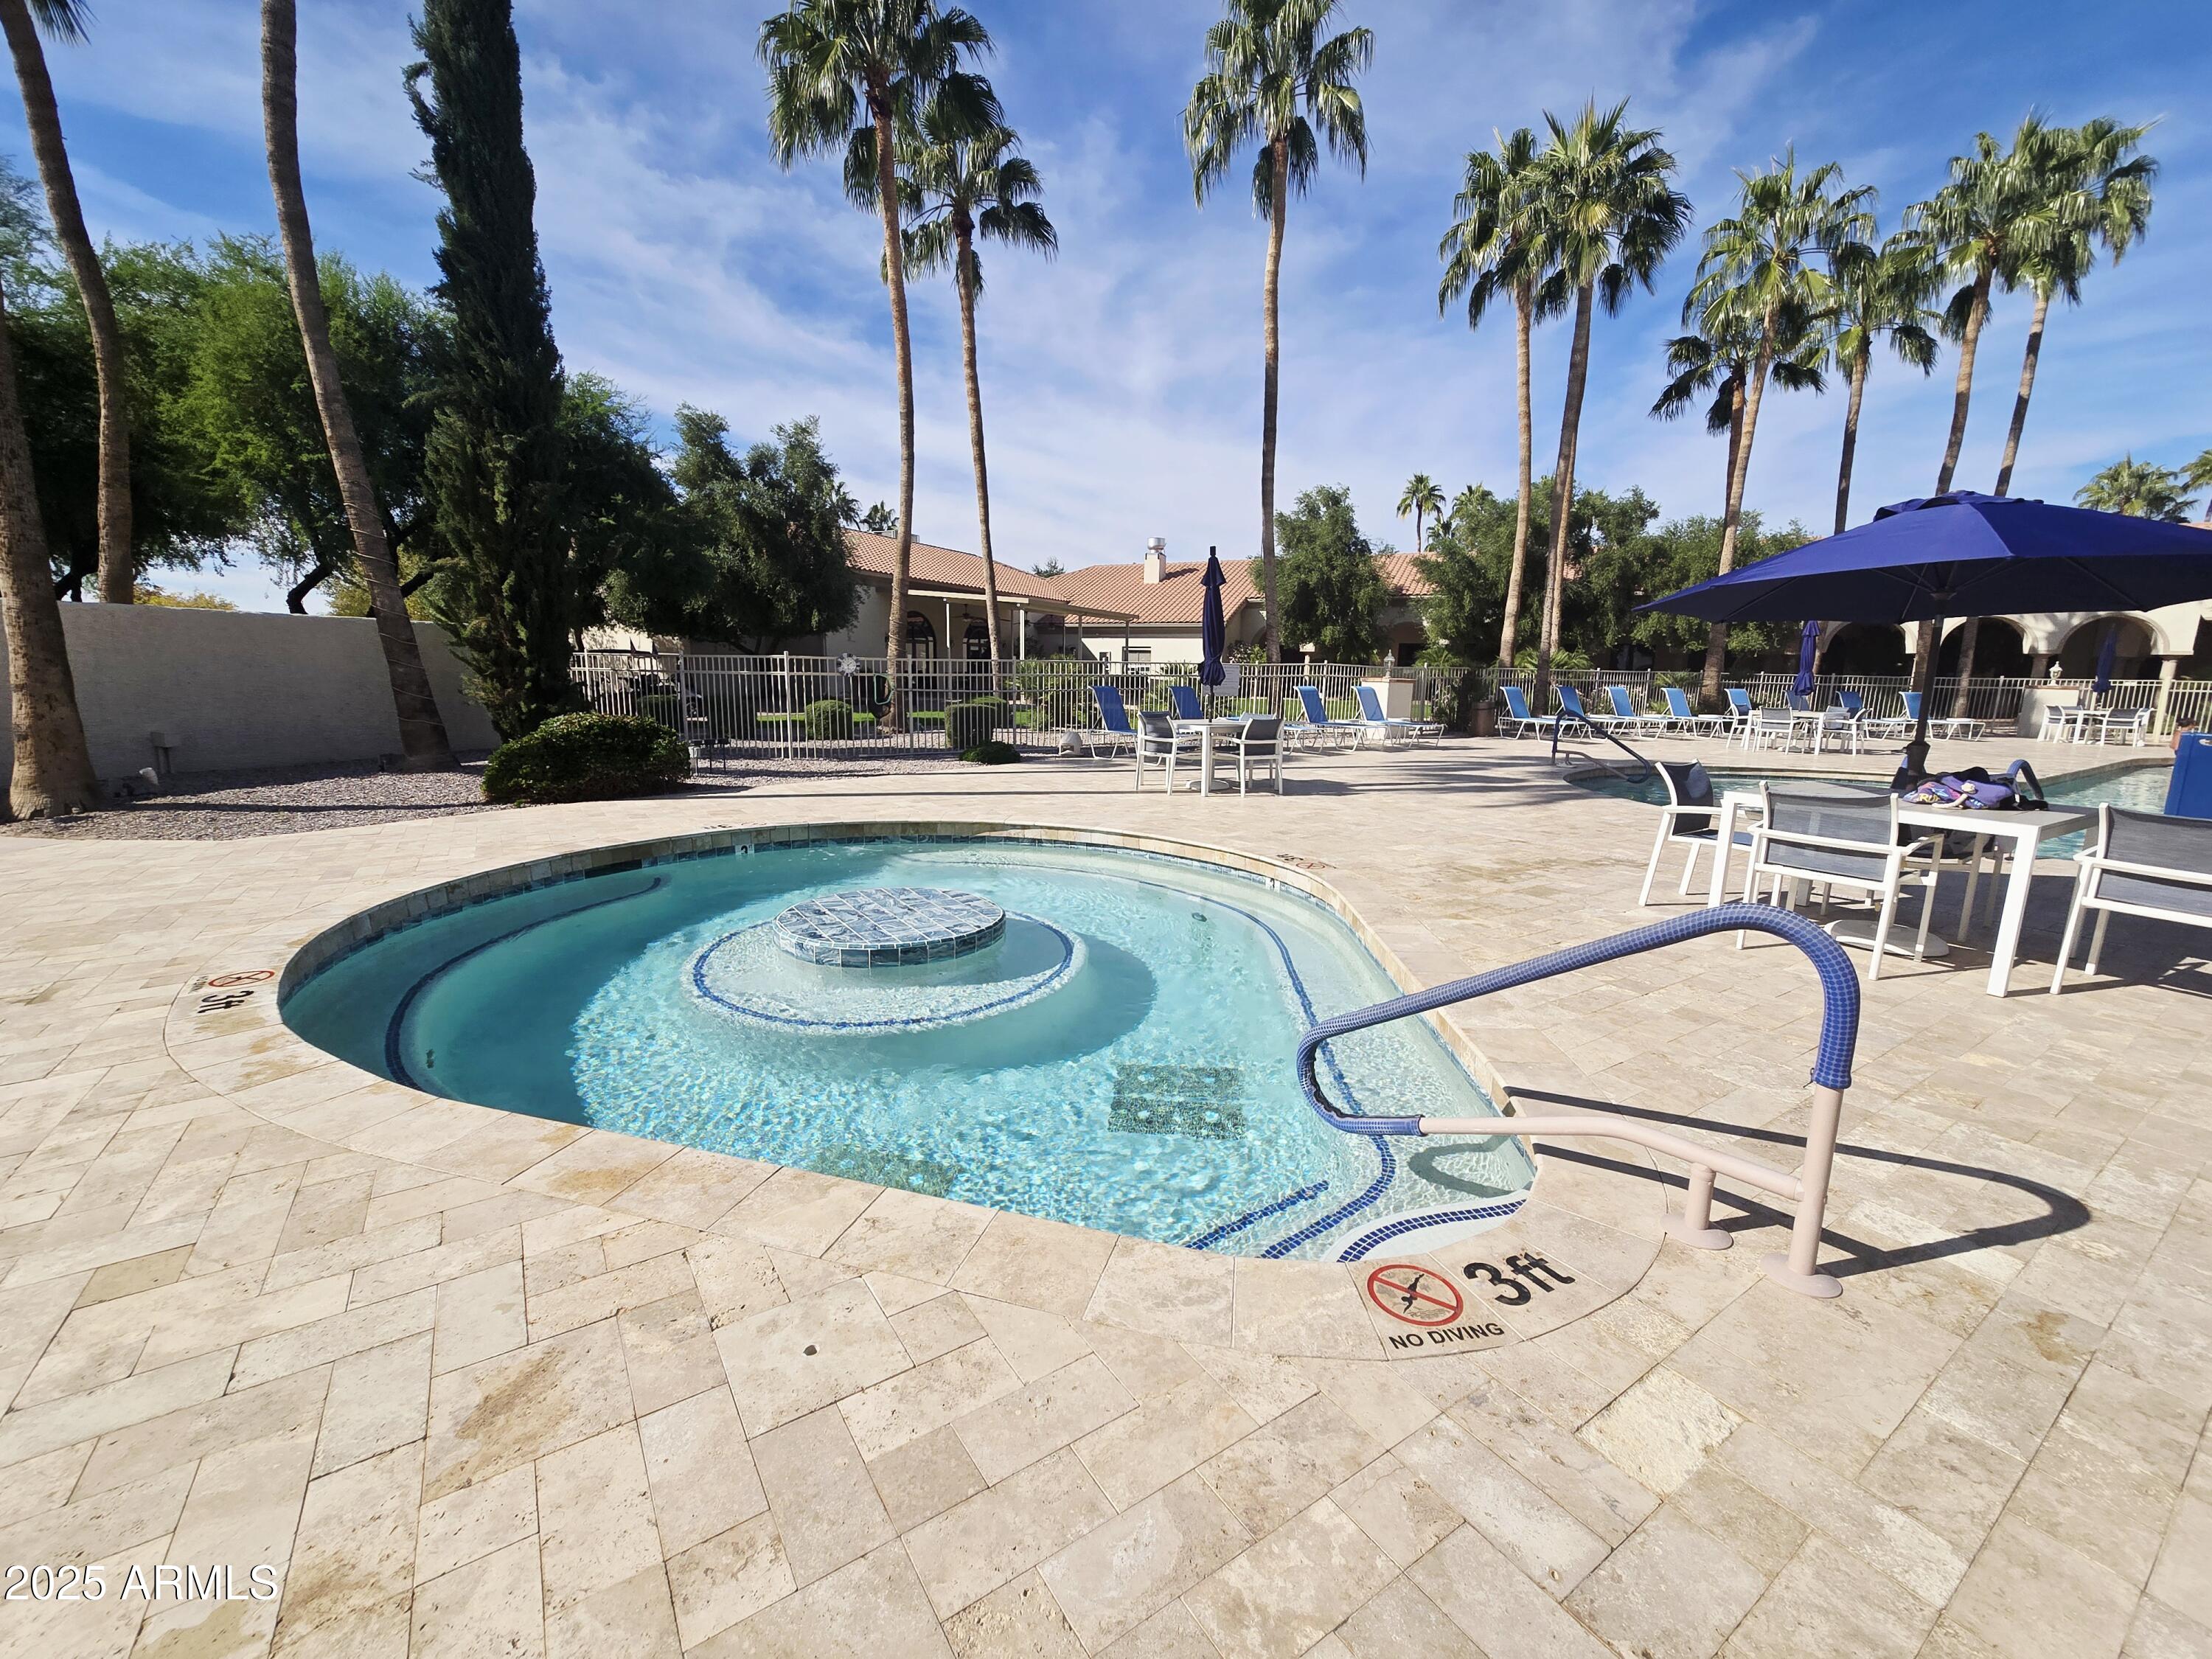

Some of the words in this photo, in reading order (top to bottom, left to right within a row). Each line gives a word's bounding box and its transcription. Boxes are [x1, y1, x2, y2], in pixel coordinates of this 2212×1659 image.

[197, 990, 254, 1014] 3ft
[1463, 1252, 1576, 1306] 3ft
[1388, 1332, 1424, 1350] NO
[1427, 1323, 1505, 1344] DIVING
